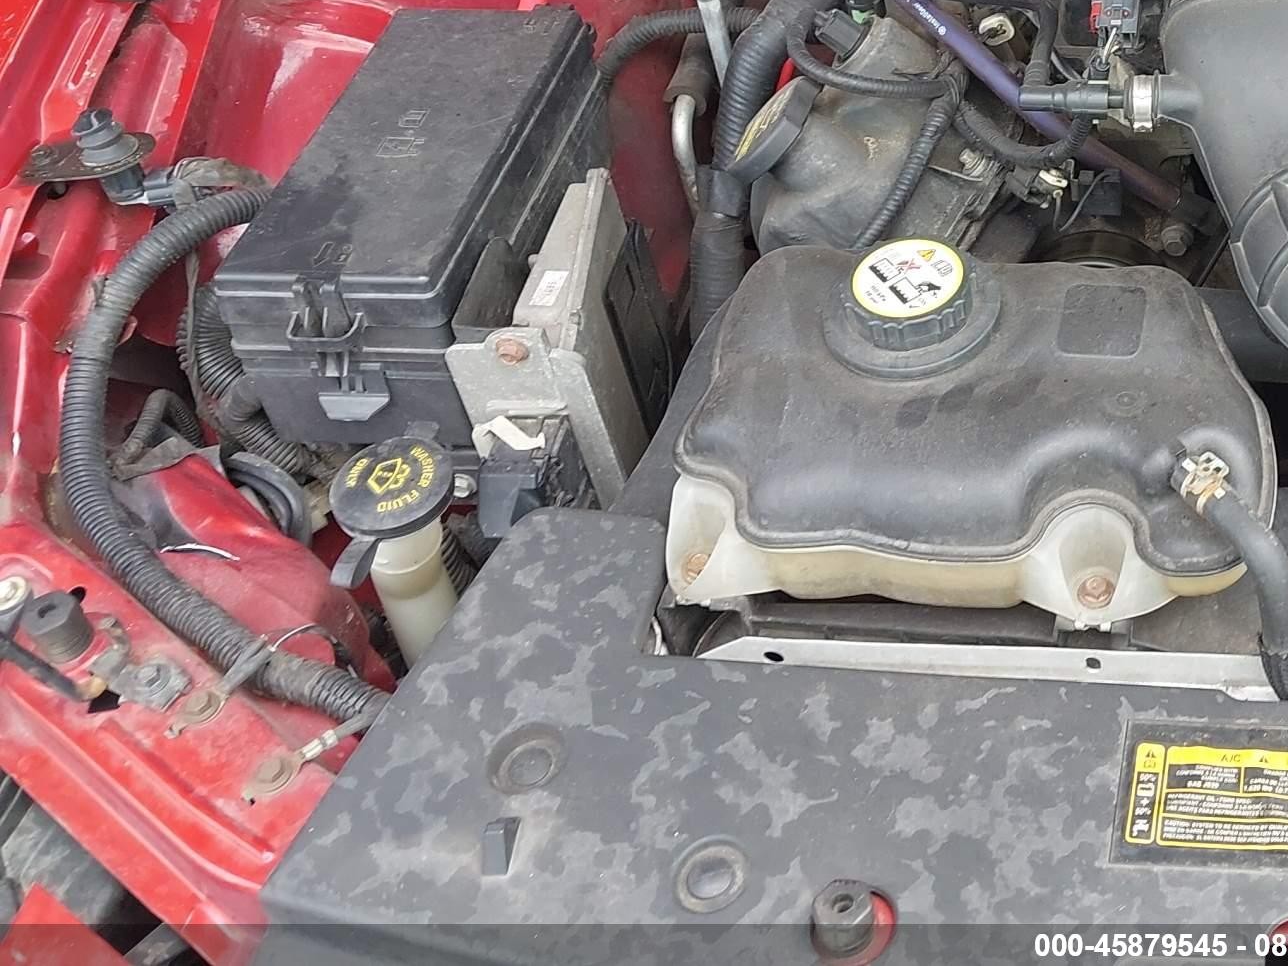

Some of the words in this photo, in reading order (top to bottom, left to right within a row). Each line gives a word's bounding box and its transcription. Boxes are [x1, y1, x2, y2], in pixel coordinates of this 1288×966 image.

[345, 458, 371, 488] ONLY
[409, 445, 435, 488] WASHER
[377, 489, 420, 513] FLUID
[1220, 753, 1241, 764] A/C
